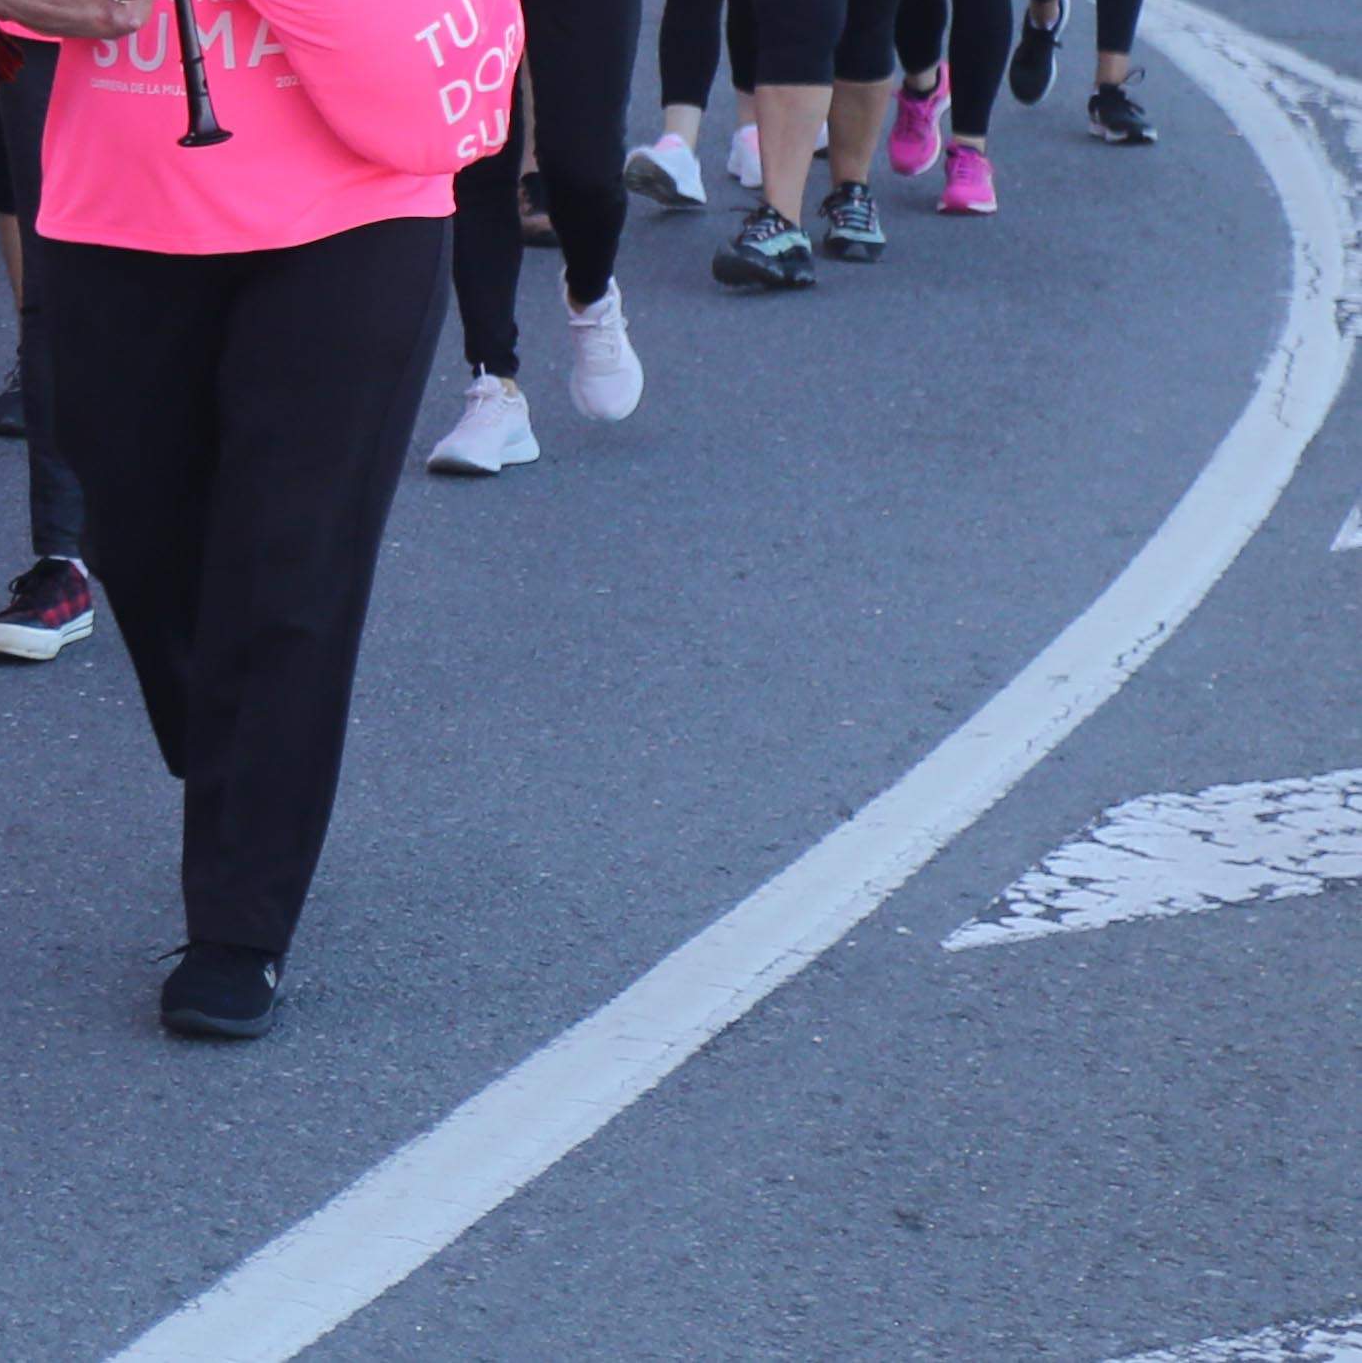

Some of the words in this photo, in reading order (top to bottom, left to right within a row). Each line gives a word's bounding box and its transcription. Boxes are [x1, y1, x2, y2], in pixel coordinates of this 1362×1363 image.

[162, 83, 187, 97] MUJ
[276, 76, 300, 89] 202
[439, 23, 517, 125] DOR
[457, 109, 509, 159] SU
